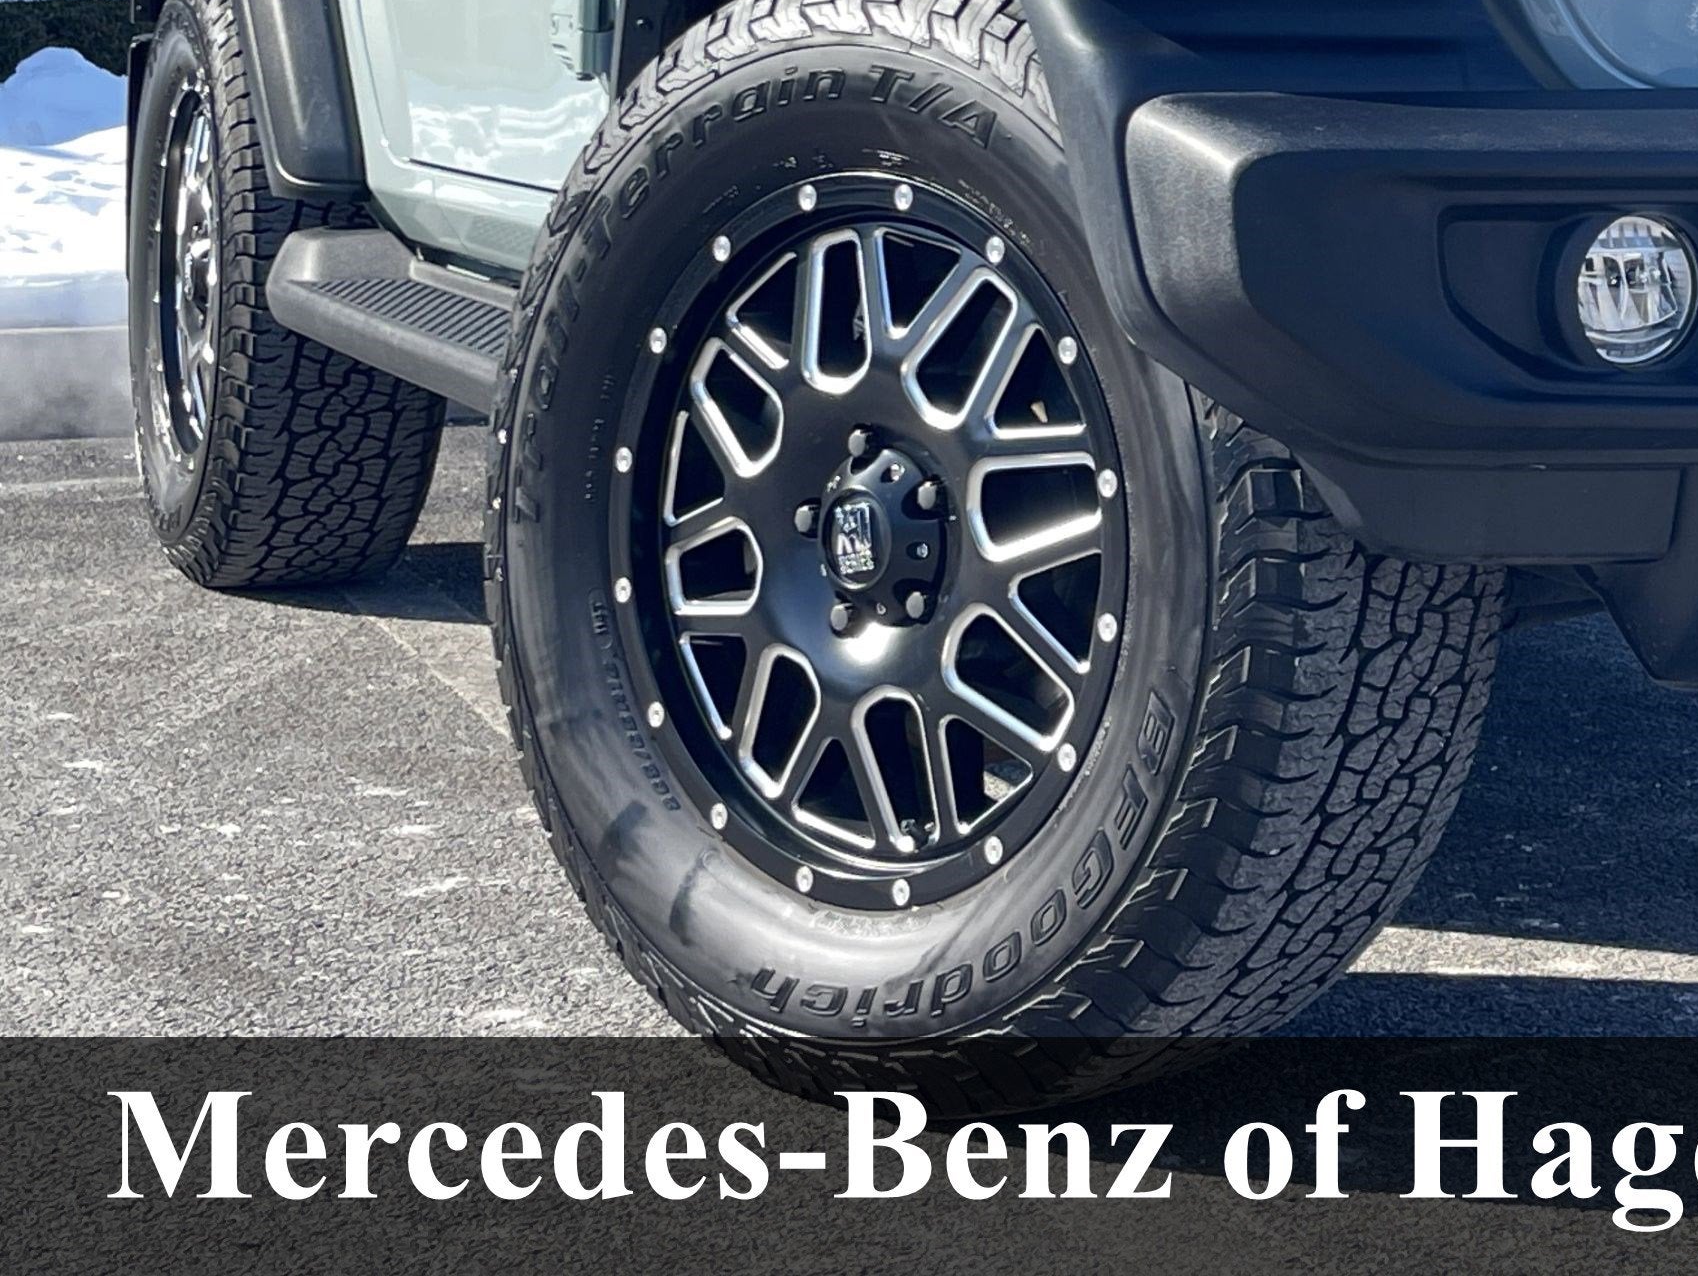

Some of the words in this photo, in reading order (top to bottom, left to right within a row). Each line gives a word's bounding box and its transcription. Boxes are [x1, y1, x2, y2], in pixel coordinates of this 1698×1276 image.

[514, 65, 848, 523] Trail-Terrain
[866, 64, 1002, 151] T/A
[749, 690, 1176, 1027] BFGoodrich
